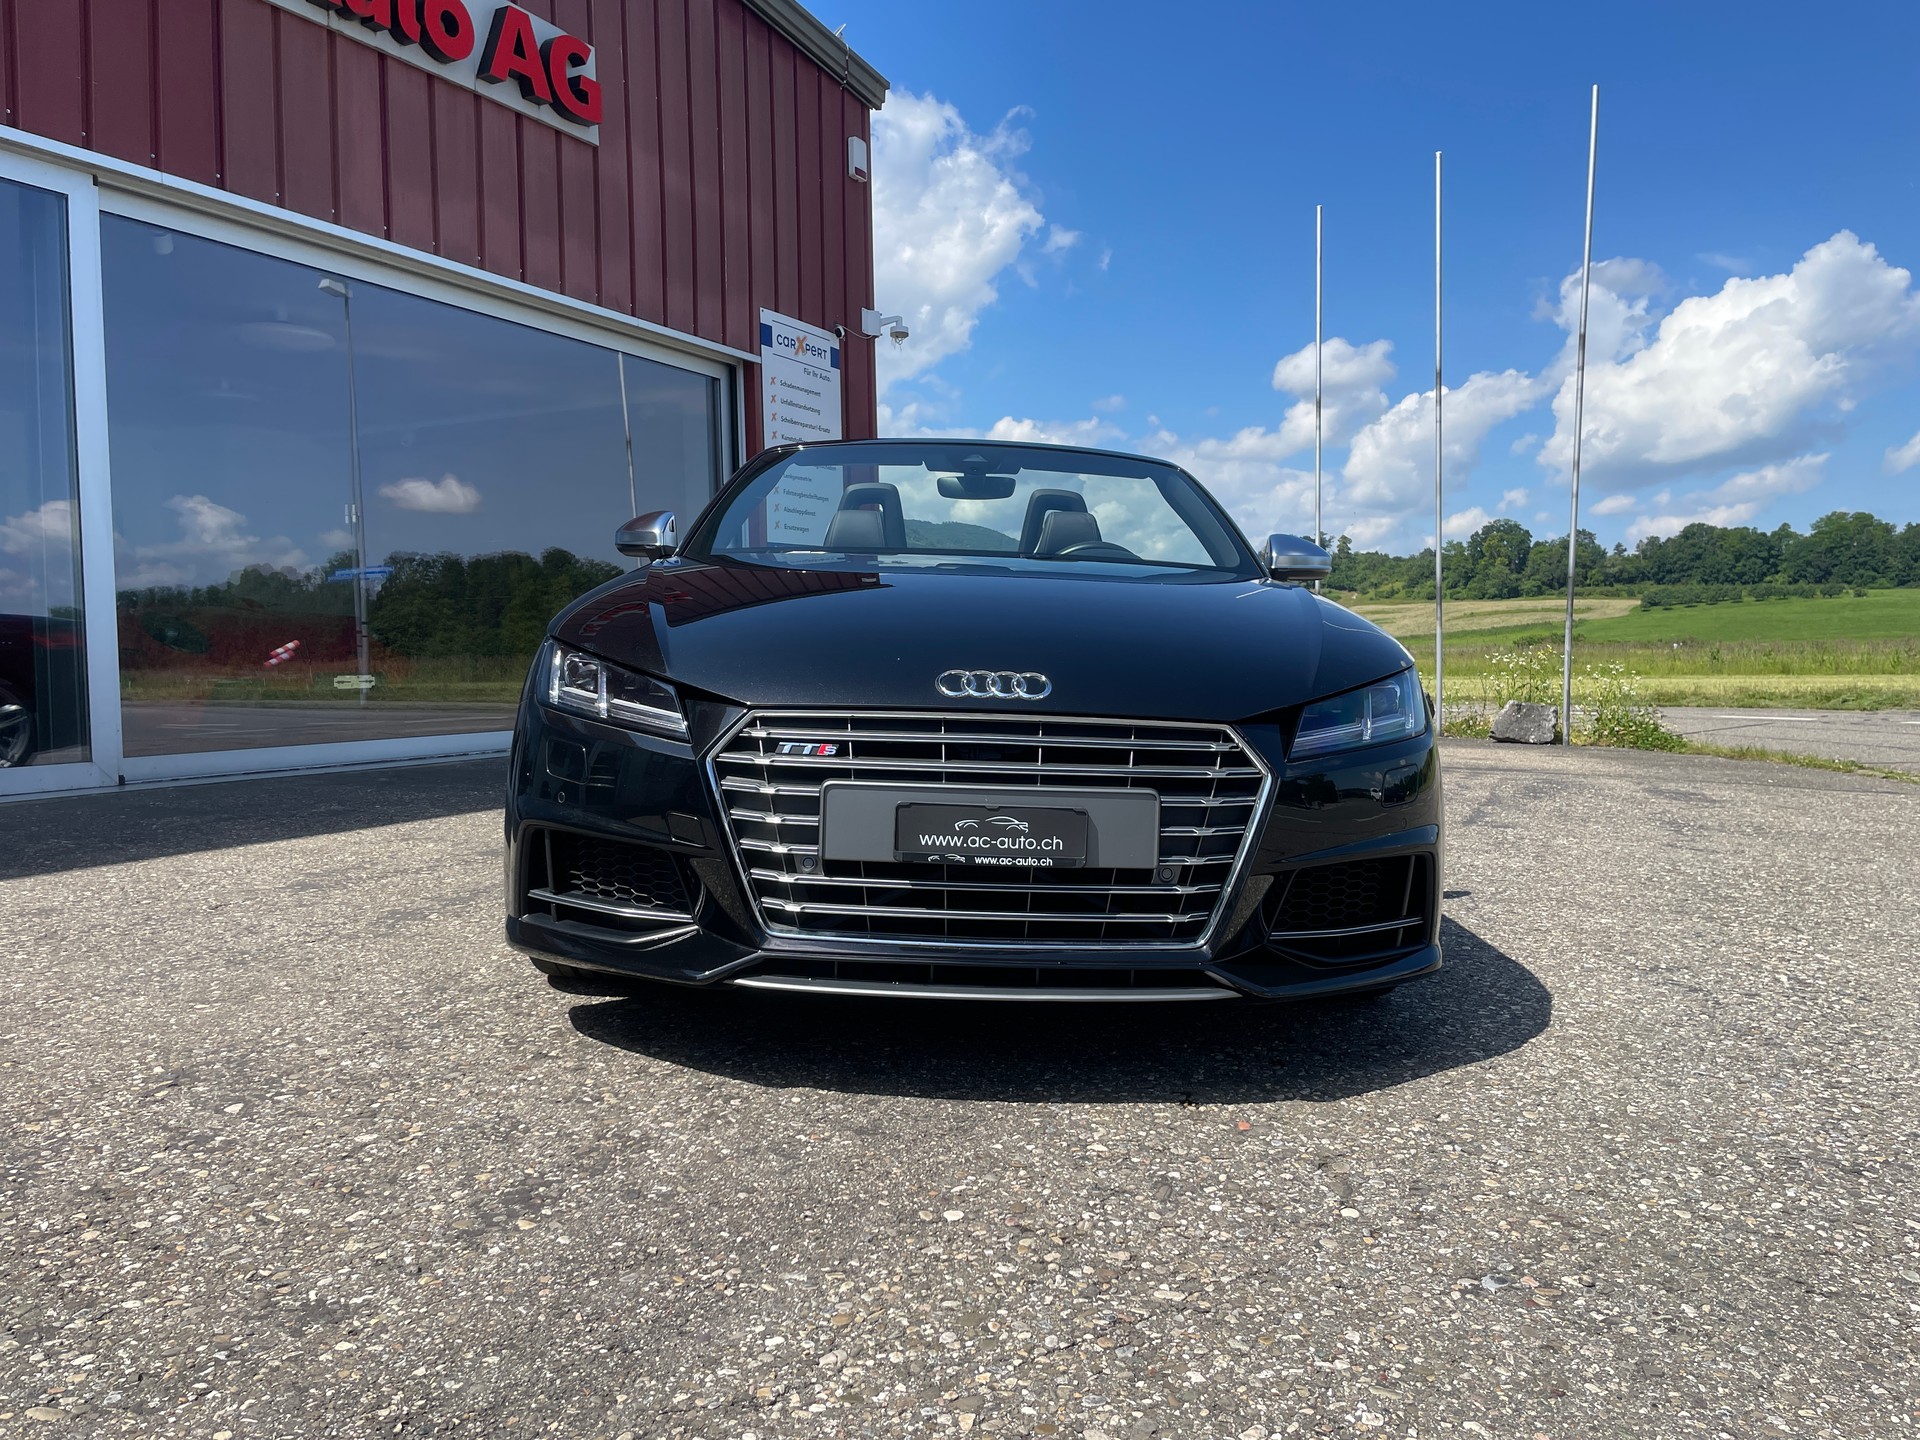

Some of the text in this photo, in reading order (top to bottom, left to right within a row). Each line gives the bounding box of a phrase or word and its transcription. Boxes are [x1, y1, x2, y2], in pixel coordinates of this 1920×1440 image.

[478, 5, 603, 127] AG
[777, 741, 838, 755] TTS
[919, 834, 1063, 850] www.ac-auto.ch
[974, 856, 1053, 867] www.ac-auto.ch
